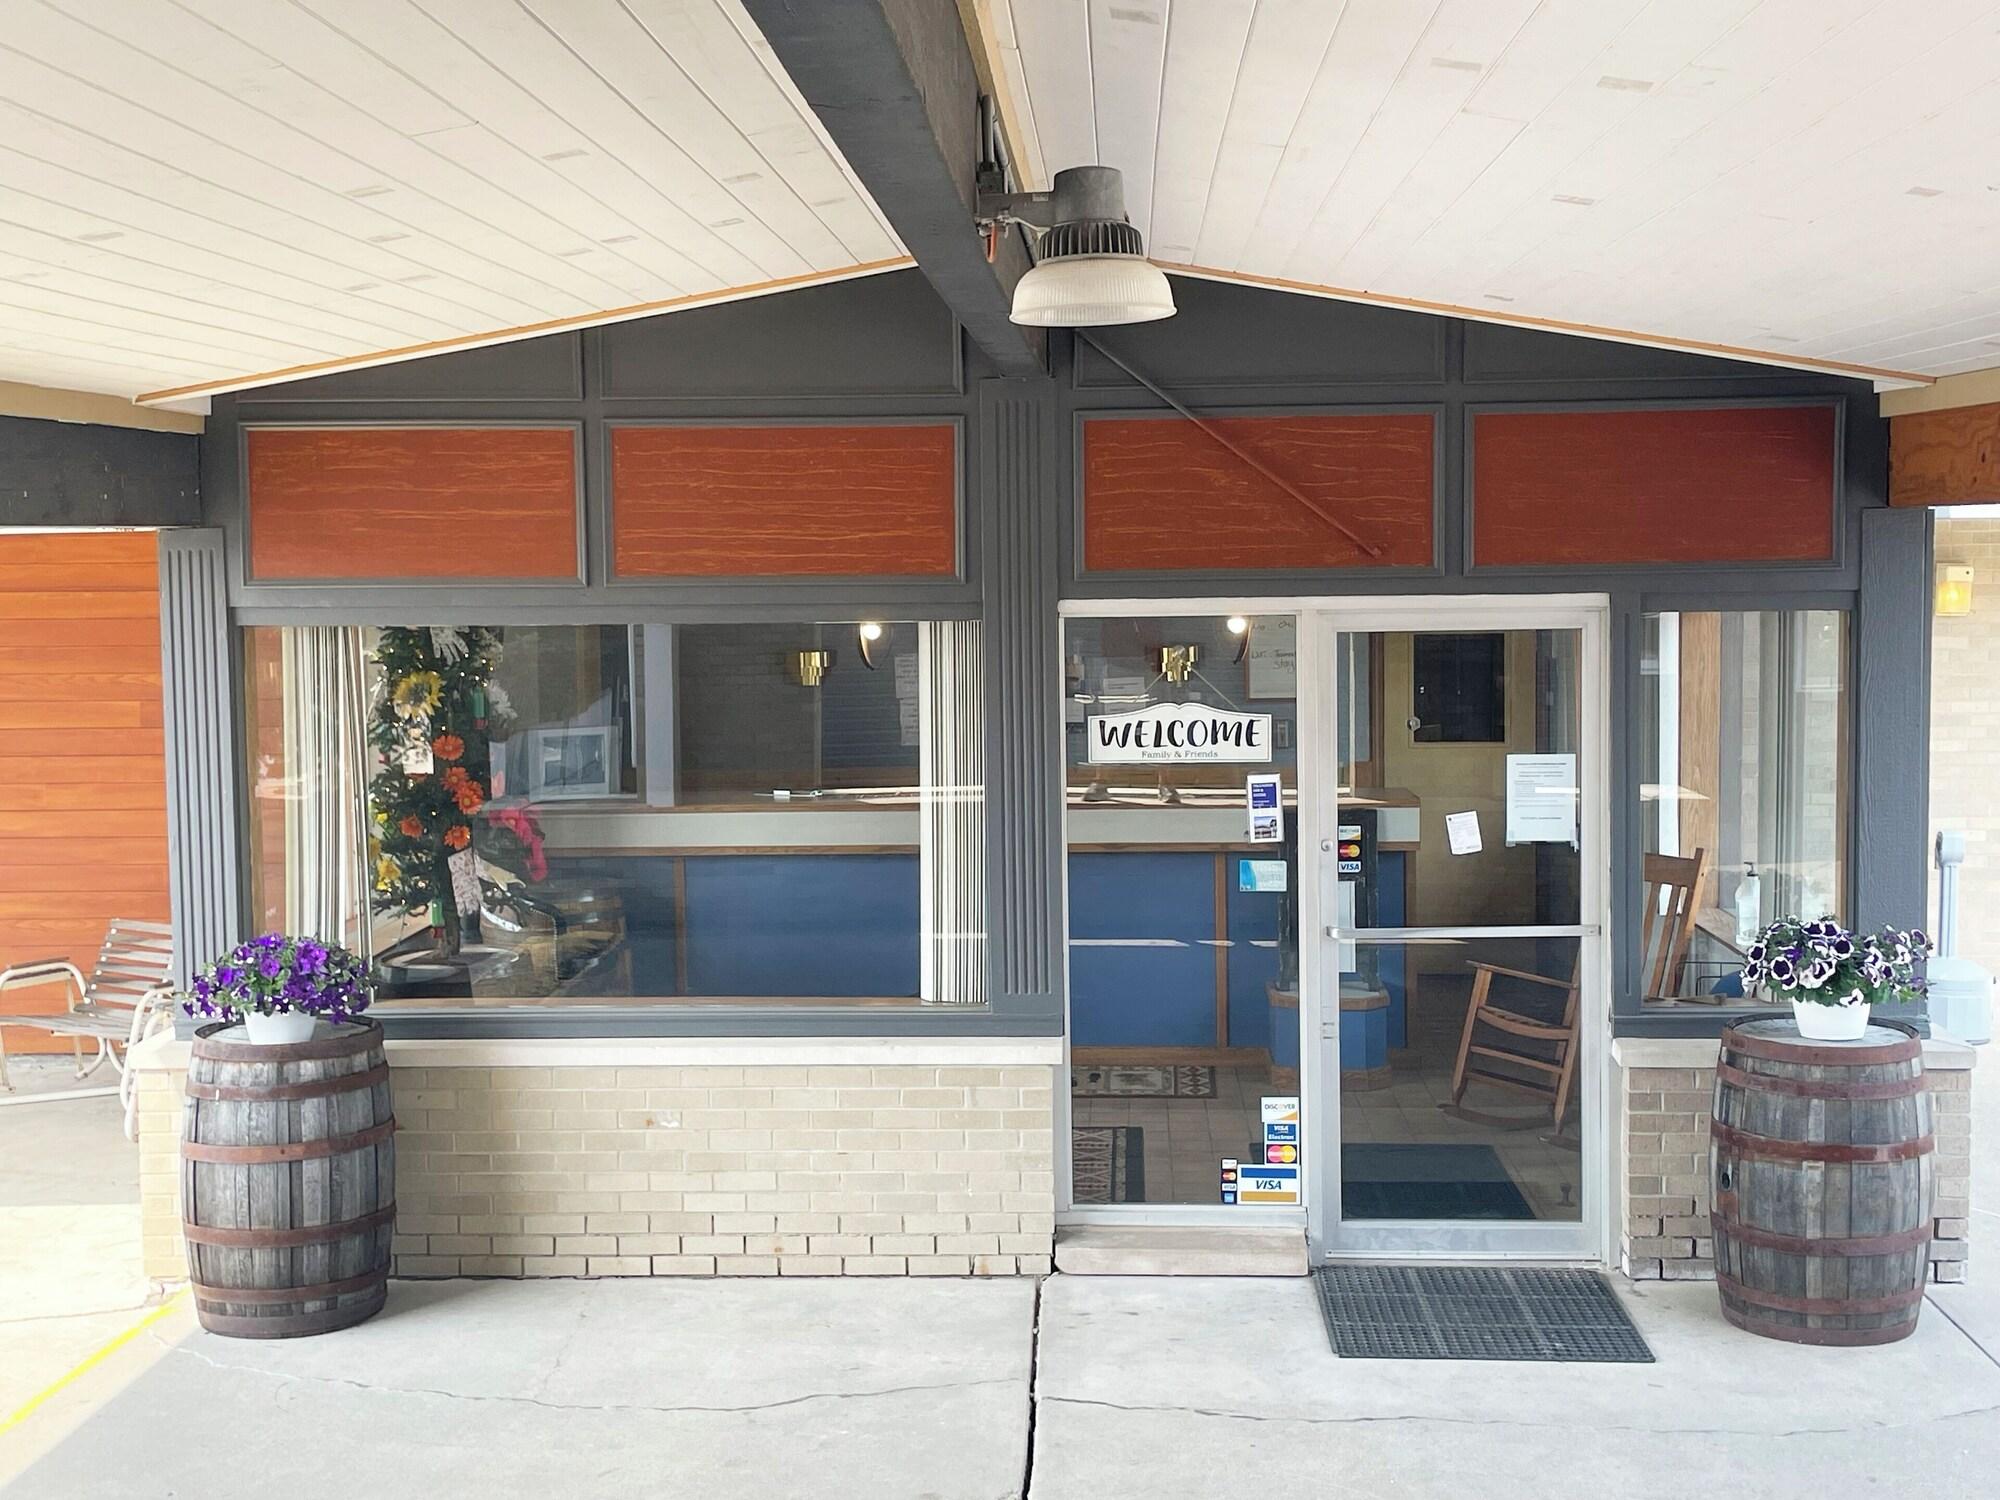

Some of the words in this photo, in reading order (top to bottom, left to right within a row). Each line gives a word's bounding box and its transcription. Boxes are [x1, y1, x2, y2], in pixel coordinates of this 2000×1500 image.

[1098, 719, 1262, 748] WELCOME
[1141, 750, 1172, 759] Family
[1174, 750, 1182, 758] &
[1184, 750, 1218, 758] Friends
[1340, 863, 1360, 871] VISA
[1255, 1180, 1282, 1190] VISA
